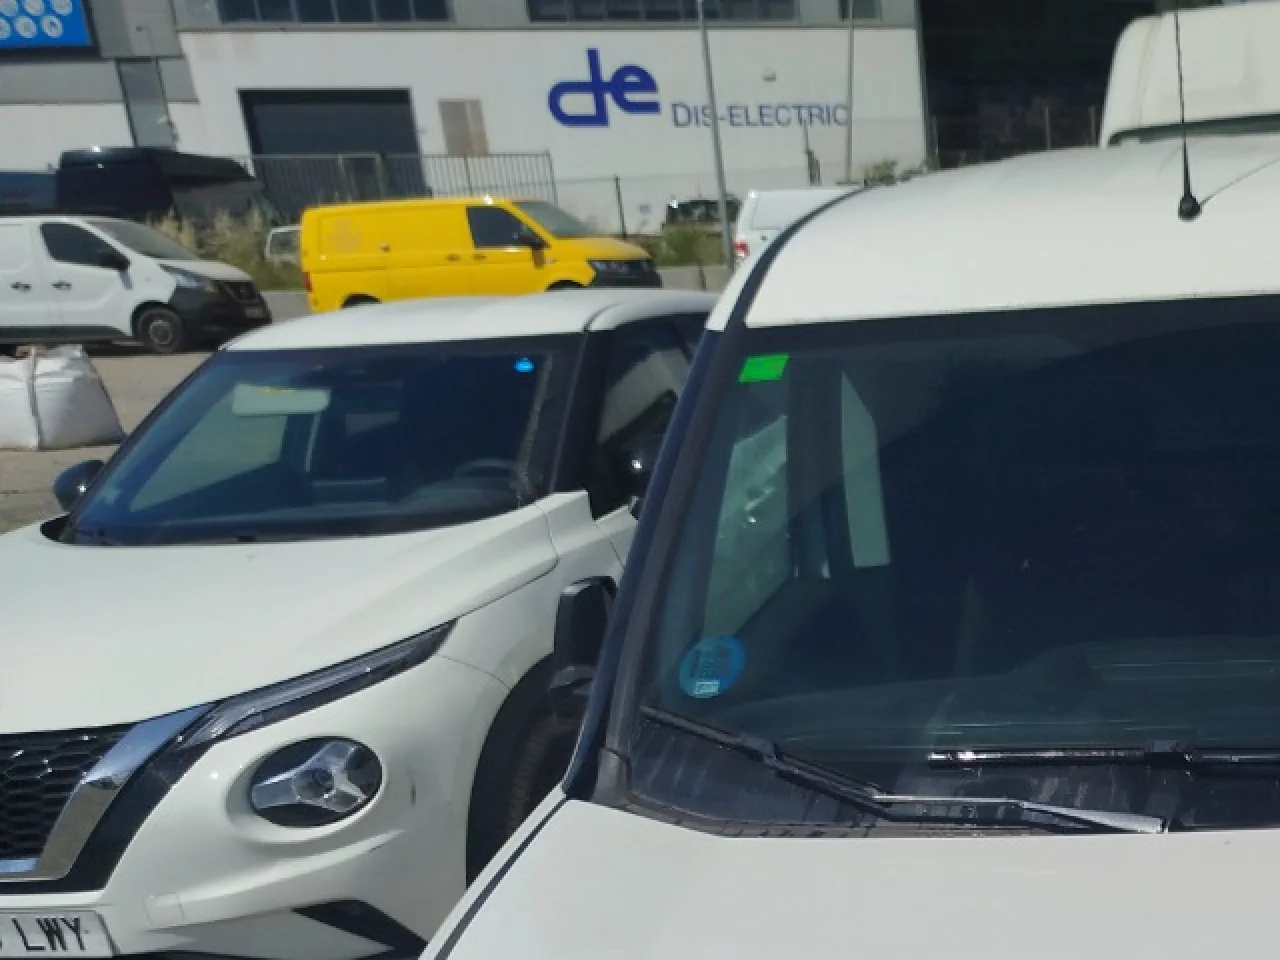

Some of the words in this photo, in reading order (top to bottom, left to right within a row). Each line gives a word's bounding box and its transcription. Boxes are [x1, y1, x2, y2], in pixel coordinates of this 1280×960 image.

[548, 48, 661, 126] de
[671, 102, 849, 127] DIS-ELECTRIC
[11, 917, 86, 951] LWY
